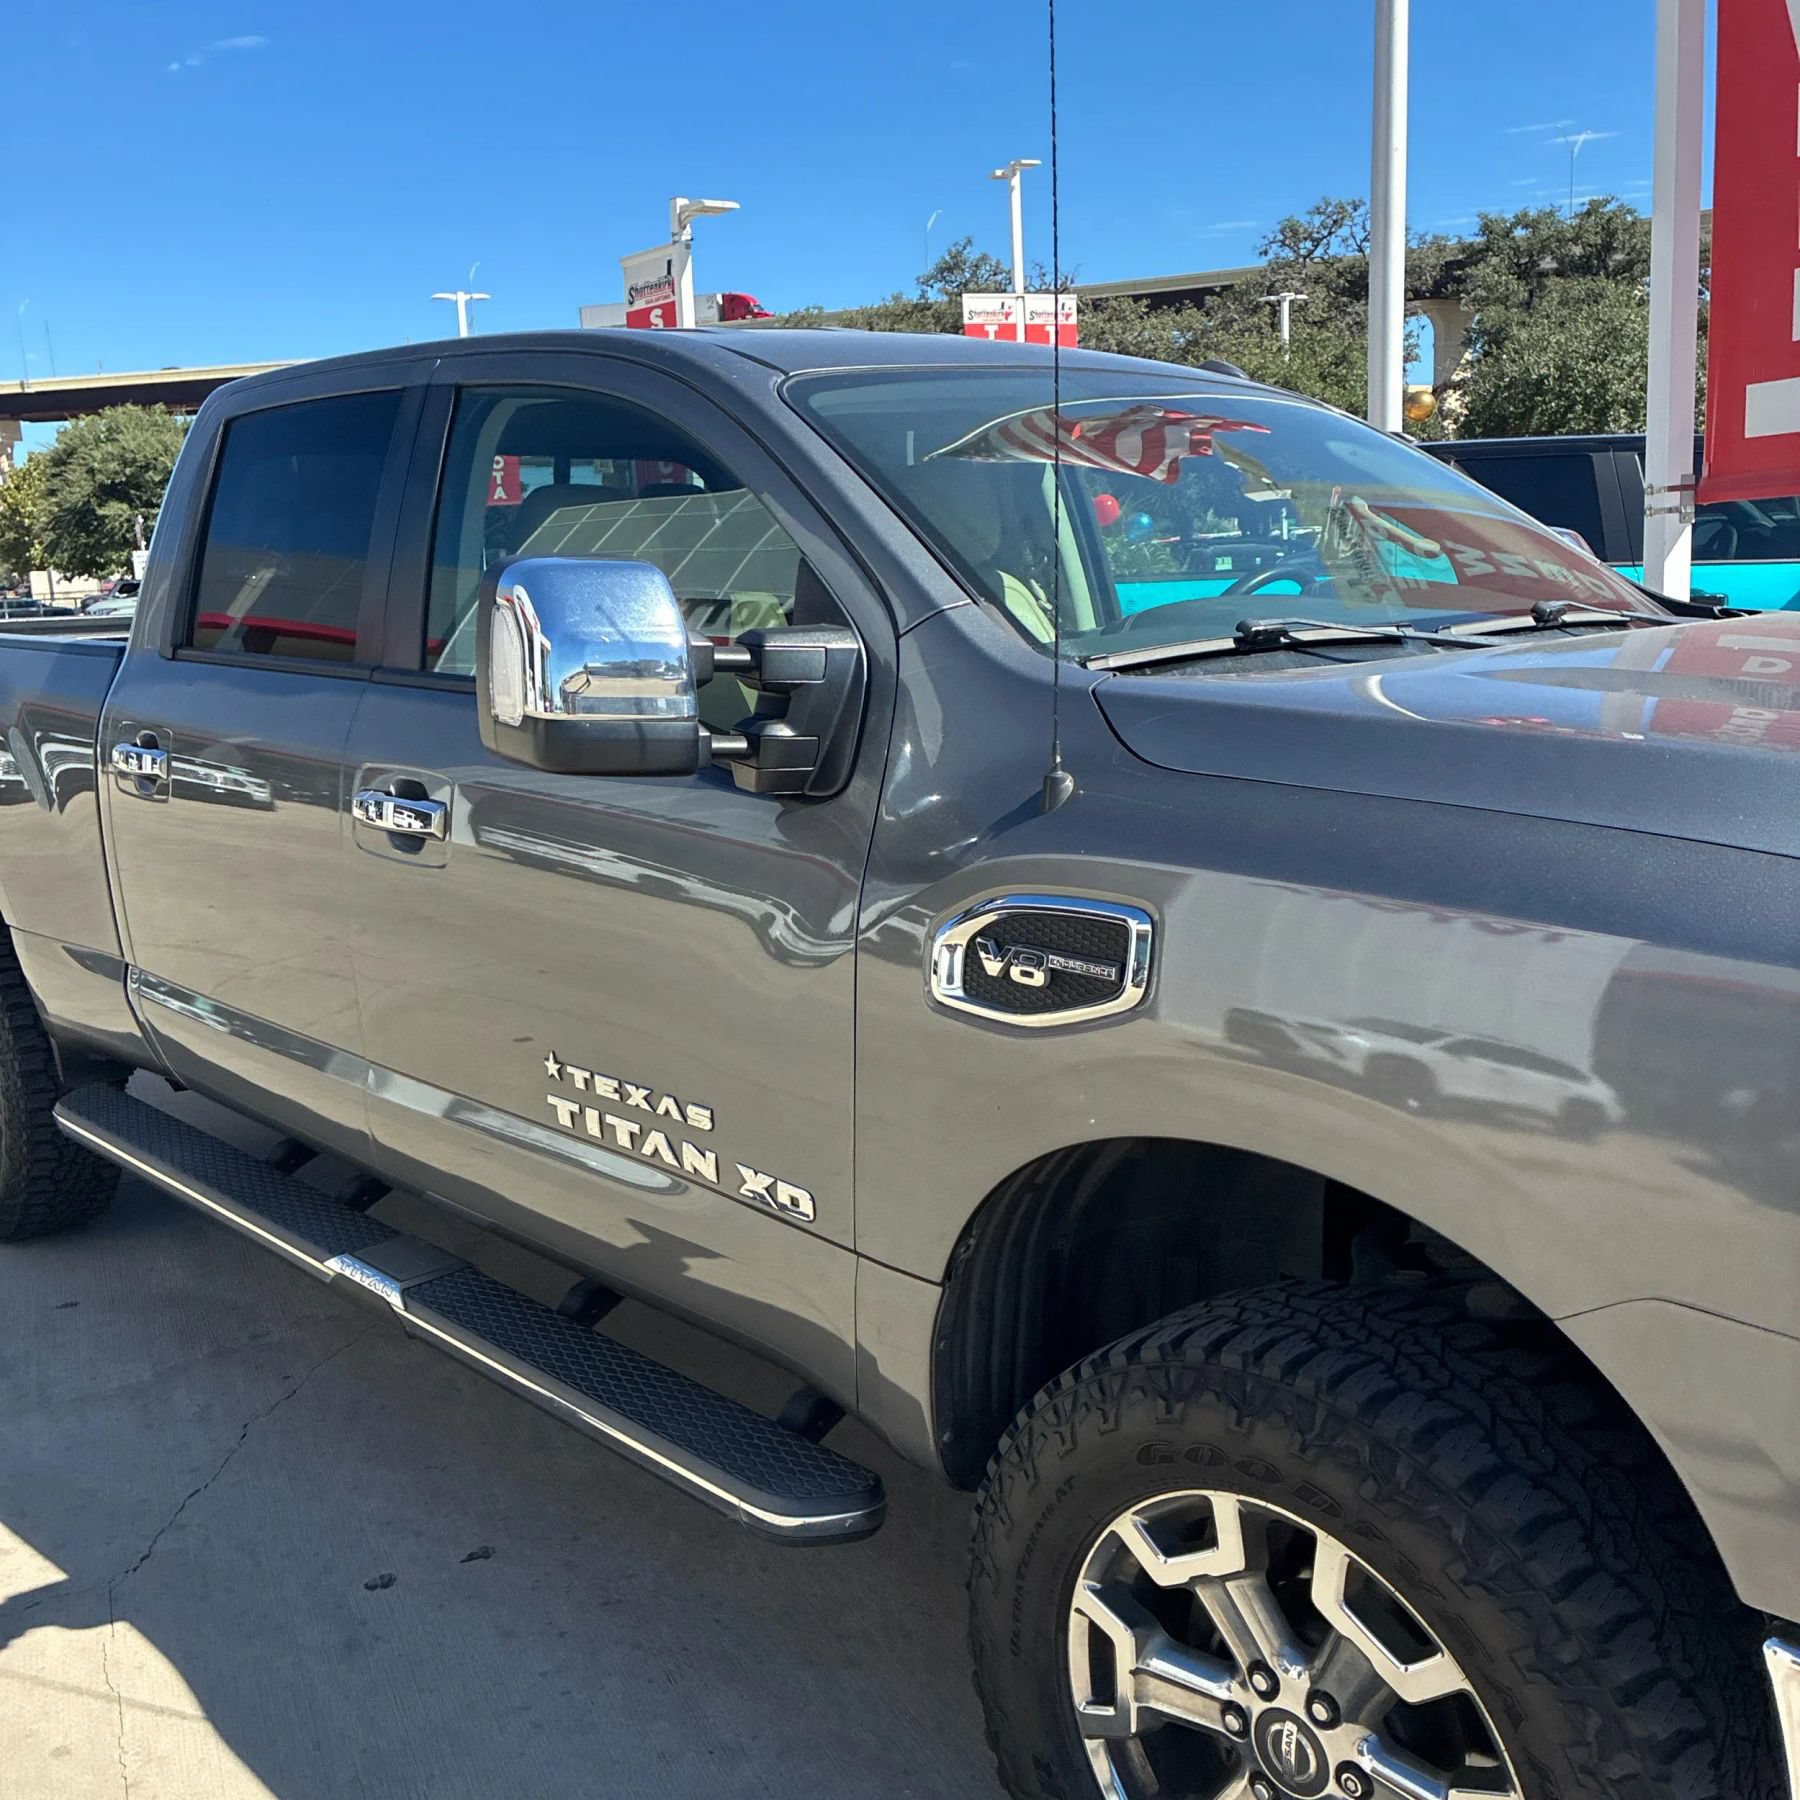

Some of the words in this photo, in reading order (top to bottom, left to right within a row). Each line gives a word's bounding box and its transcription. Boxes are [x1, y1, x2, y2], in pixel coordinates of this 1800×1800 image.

[976, 937, 1048, 988] V8
[566, 1064, 714, 1131] TEXAS
[547, 1094, 719, 1184] TITAN
[735, 1161, 816, 1223] XD
[340, 1257, 396, 1298] TITAN
